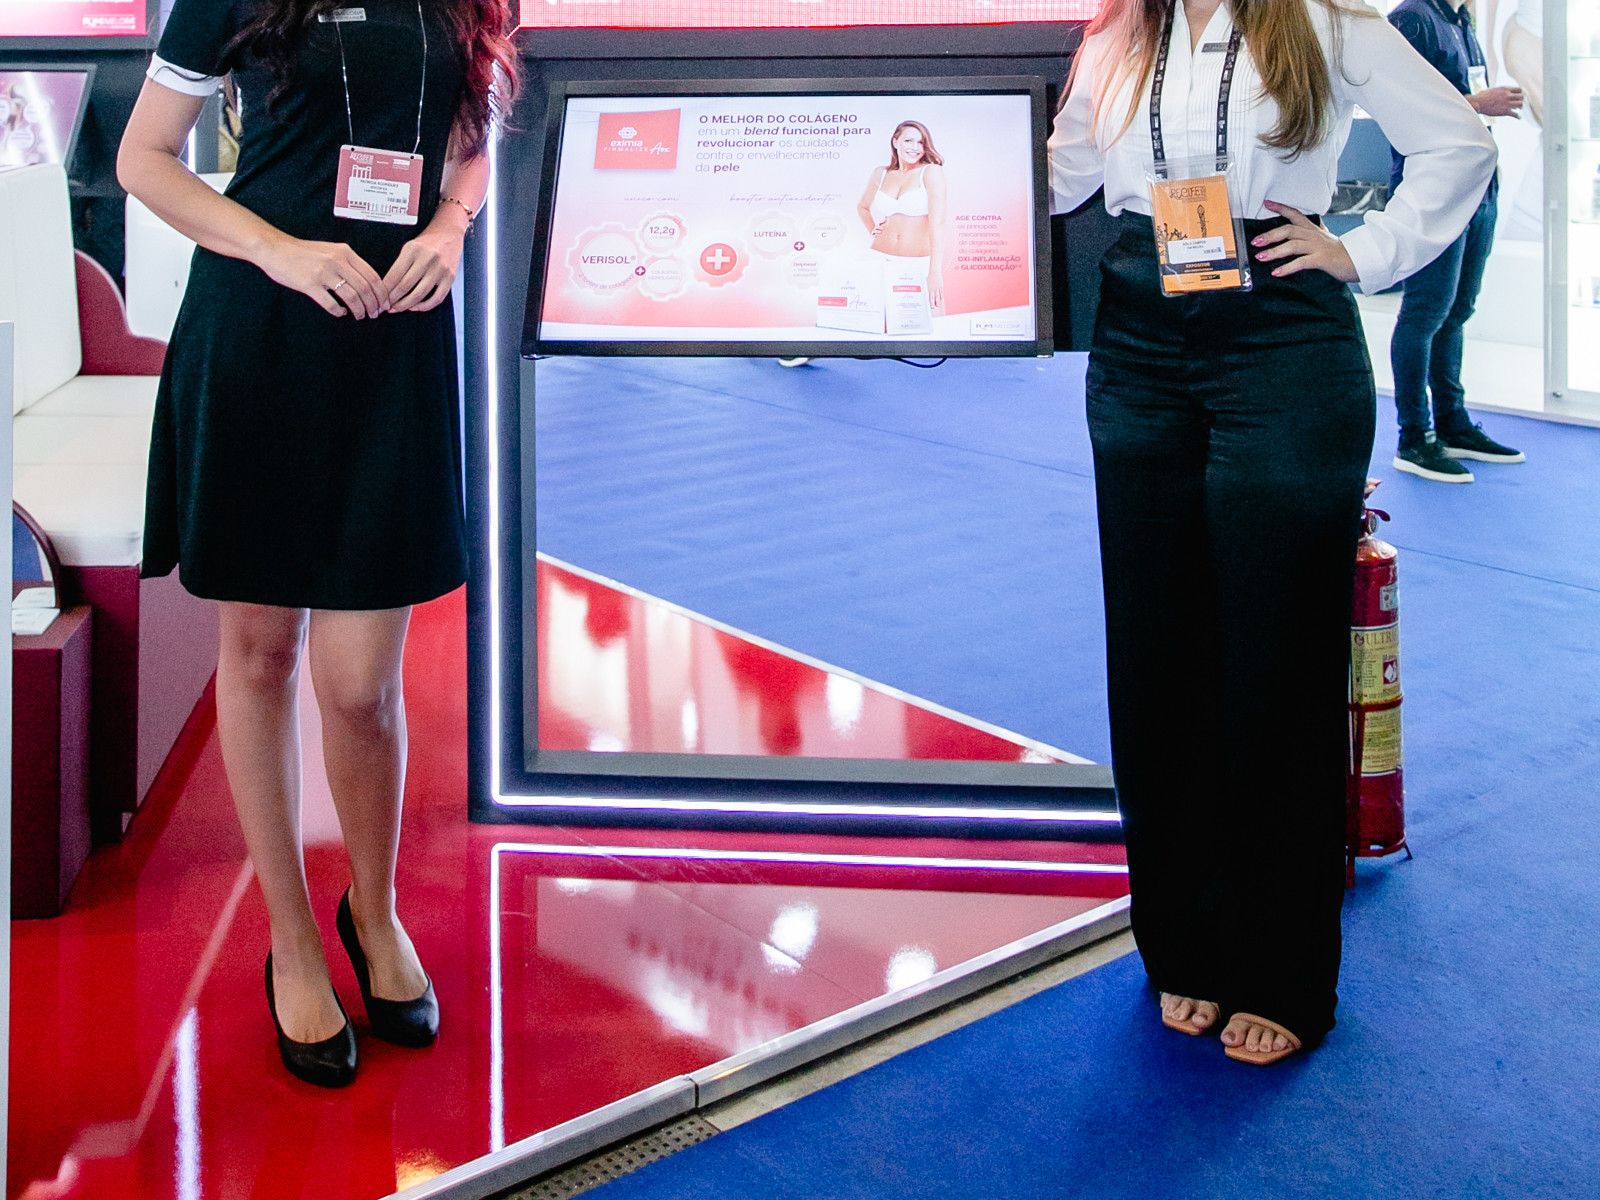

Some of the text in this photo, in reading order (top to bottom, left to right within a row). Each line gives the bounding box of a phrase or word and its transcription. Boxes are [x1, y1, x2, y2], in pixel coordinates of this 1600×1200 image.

[700, 113, 857, 123] O MELHOR DO COLÁGENO
[744, 126, 779, 135] blend
[782, 126, 839, 135] funcional
[843, 127, 871, 136] para
[697, 139, 774, 148] revolucionar
[796, 137, 849, 148] cuidados
[696, 152, 733, 160] contra
[747, 151, 840, 160] envelhecimento
[696, 163, 740, 173] da pele
[650, 226, 675, 235] 12,2g
